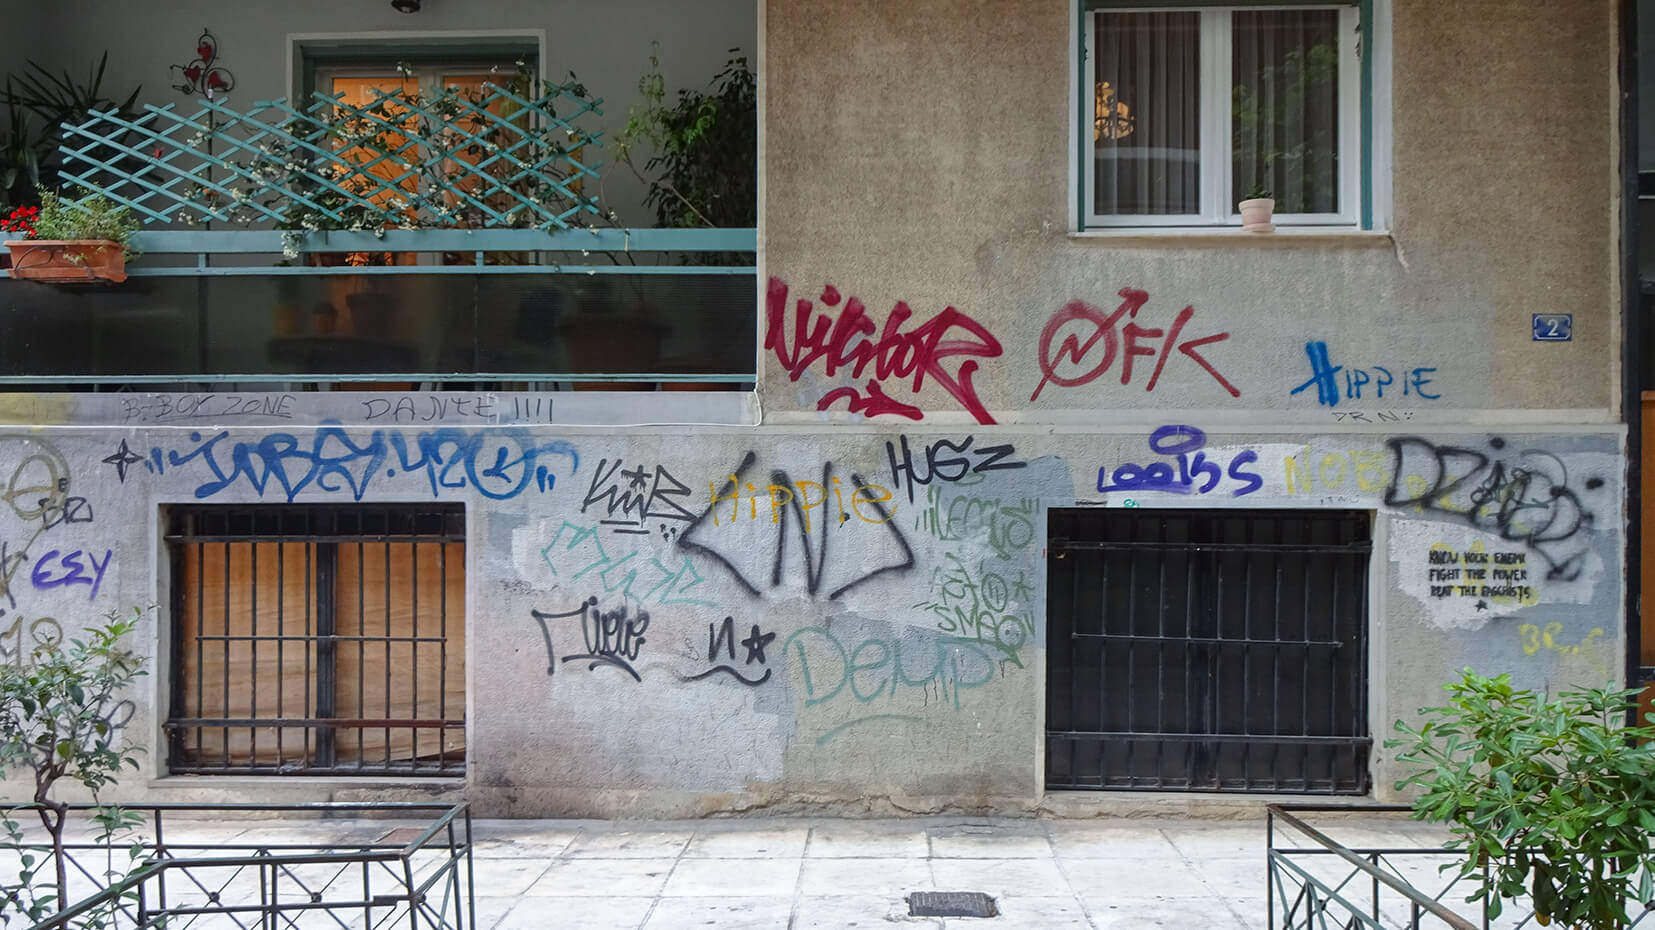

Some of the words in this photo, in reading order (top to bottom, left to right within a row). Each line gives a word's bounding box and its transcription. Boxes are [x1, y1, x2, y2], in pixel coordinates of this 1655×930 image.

[1547, 320, 1558, 336] 2
[1429, 550, 1459, 564] KNOW
[1464, 551, 1489, 564] YOUR
[1494, 552, 1526, 564] ENEMY
[1429, 568, 1461, 582] FIGHT
[1465, 568, 1487, 580] THE
[1493, 568, 1527, 581] POWER
[1458, 585, 1477, 597] THE
